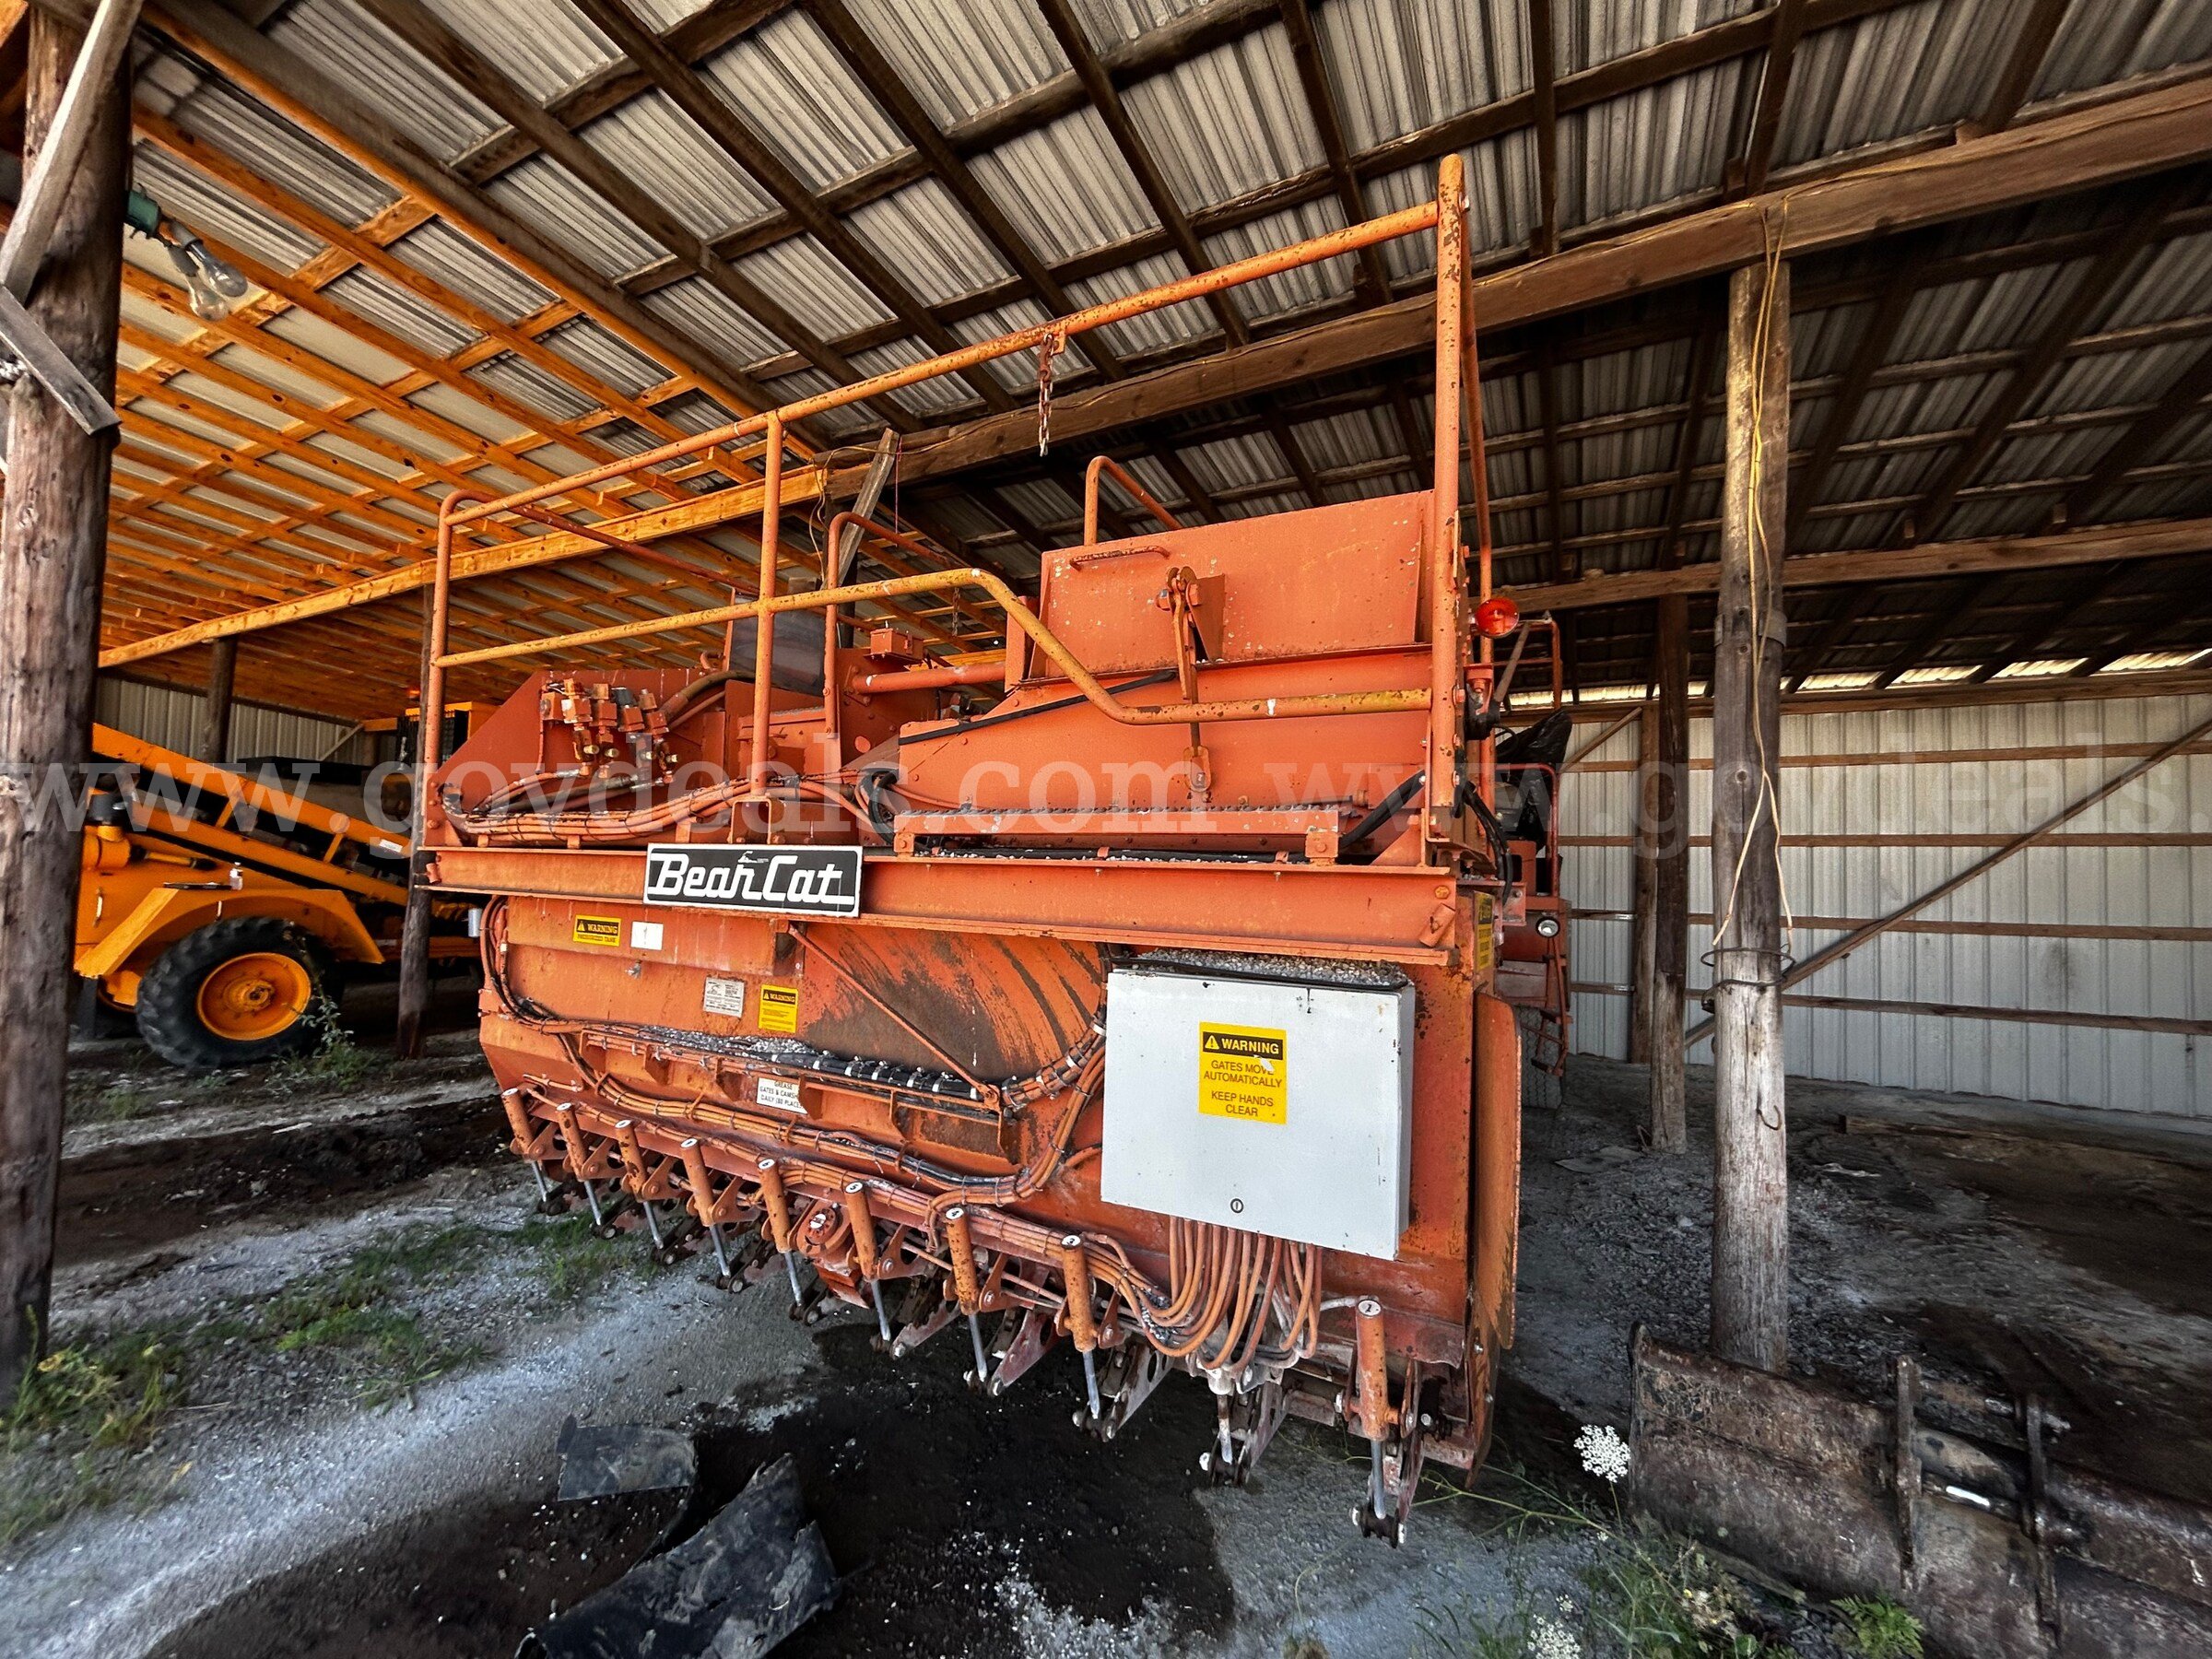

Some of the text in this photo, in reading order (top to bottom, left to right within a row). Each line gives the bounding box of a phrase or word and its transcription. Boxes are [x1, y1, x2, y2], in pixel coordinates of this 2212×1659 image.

[587, 924, 618, 935] WARNING
[770, 993, 795, 1003] WARNING
[1221, 1038, 1279, 1054] WARNING
[1211, 1060, 1275, 1076] GATES MOV
[1204, 1071, 1282, 1088] AUTOMATICALLY
[759, 1086, 774, 1094] GATES
[760, 1094, 774, 1102] DAILY
[784, 1100, 801, 1109] PLACE
[1211, 1090, 1274, 1106] KEEP HANDS
[1226, 1104, 1258, 1116] CLEAR
[1364, 1303, 1372, 1313] 1
